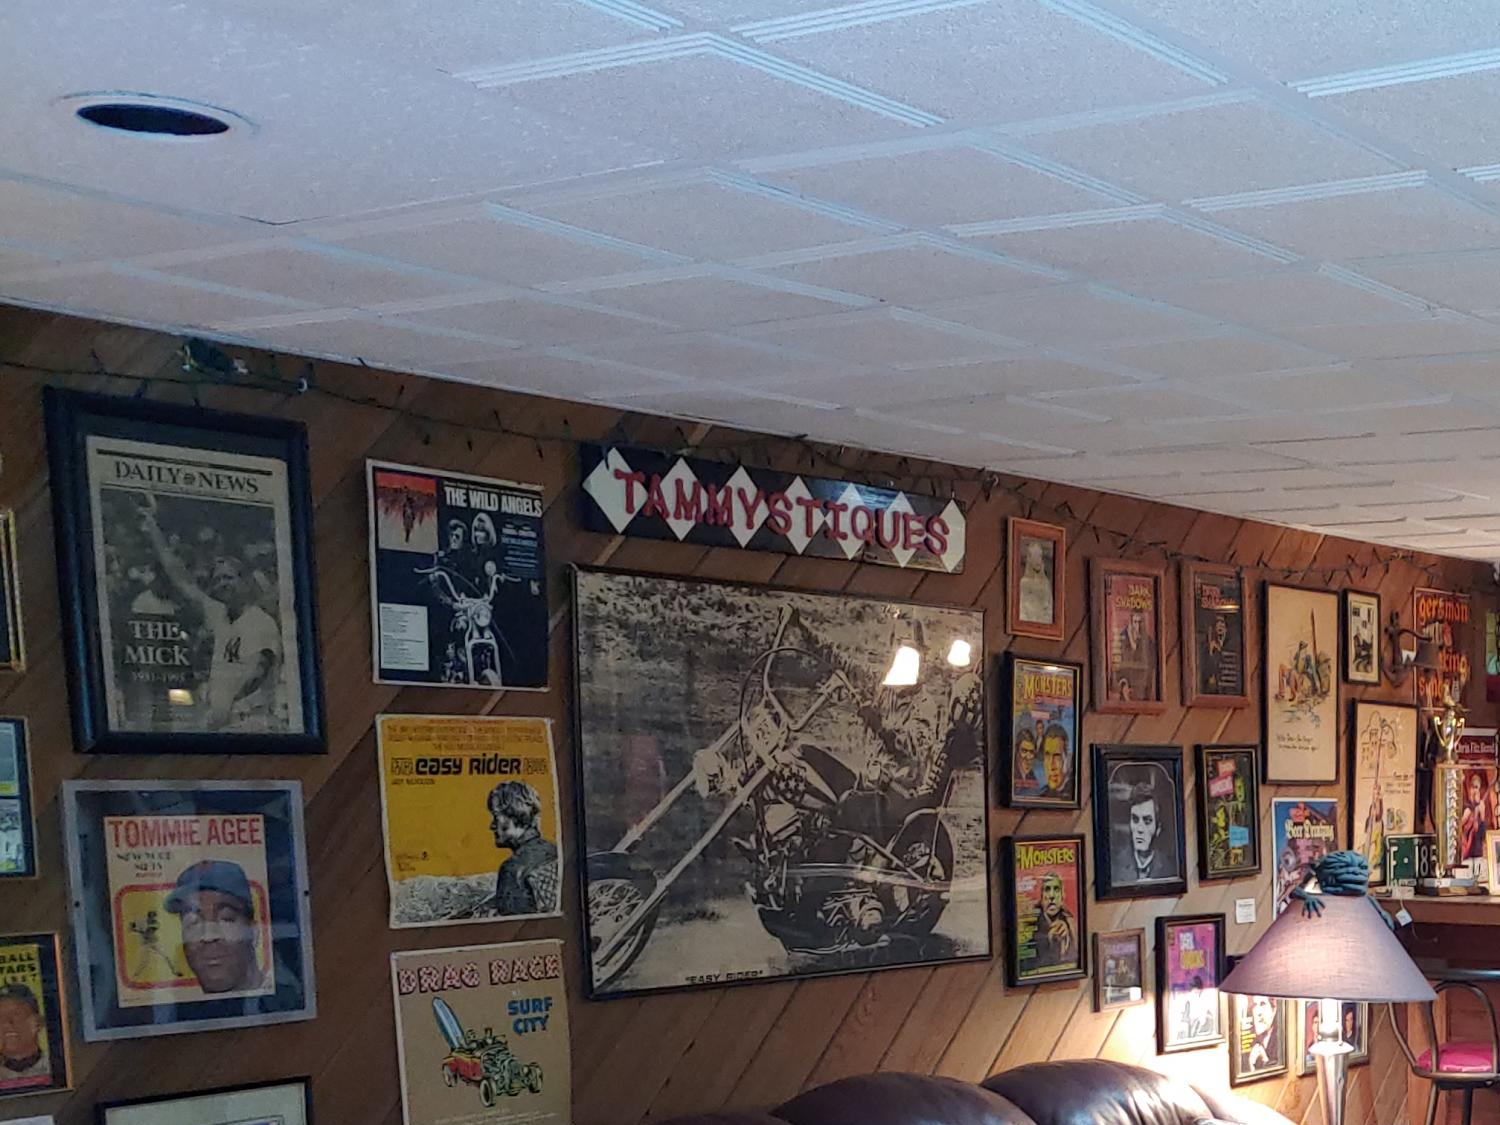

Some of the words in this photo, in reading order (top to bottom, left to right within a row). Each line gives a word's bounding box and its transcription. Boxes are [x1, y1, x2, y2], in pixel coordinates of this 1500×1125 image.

[115, 460, 180, 485] DAILY
[199, 472, 259, 494] NEWS
[443, 486, 465, 508] THE
[468, 489, 499, 512] WILD
[501, 495, 543, 518] ANGELS
[613, 468, 950, 557] TAMMYSTIQUES
[128, 620, 182, 640] THE
[124, 645, 191, 667] MICK
[1023, 673, 1073, 699] MONSTERS
[415, 757, 462, 775] easy
[107, 817, 201, 848] TOMMIE
[207, 818, 262, 846] AGEE
[1020, 846, 1075, 870] MONSTERS
[398, 962, 480, 995] DRAG
[488, 953, 560, 985] RACE
[507, 997, 553, 1016] SURF
[513, 1014, 550, 1036] CITY
